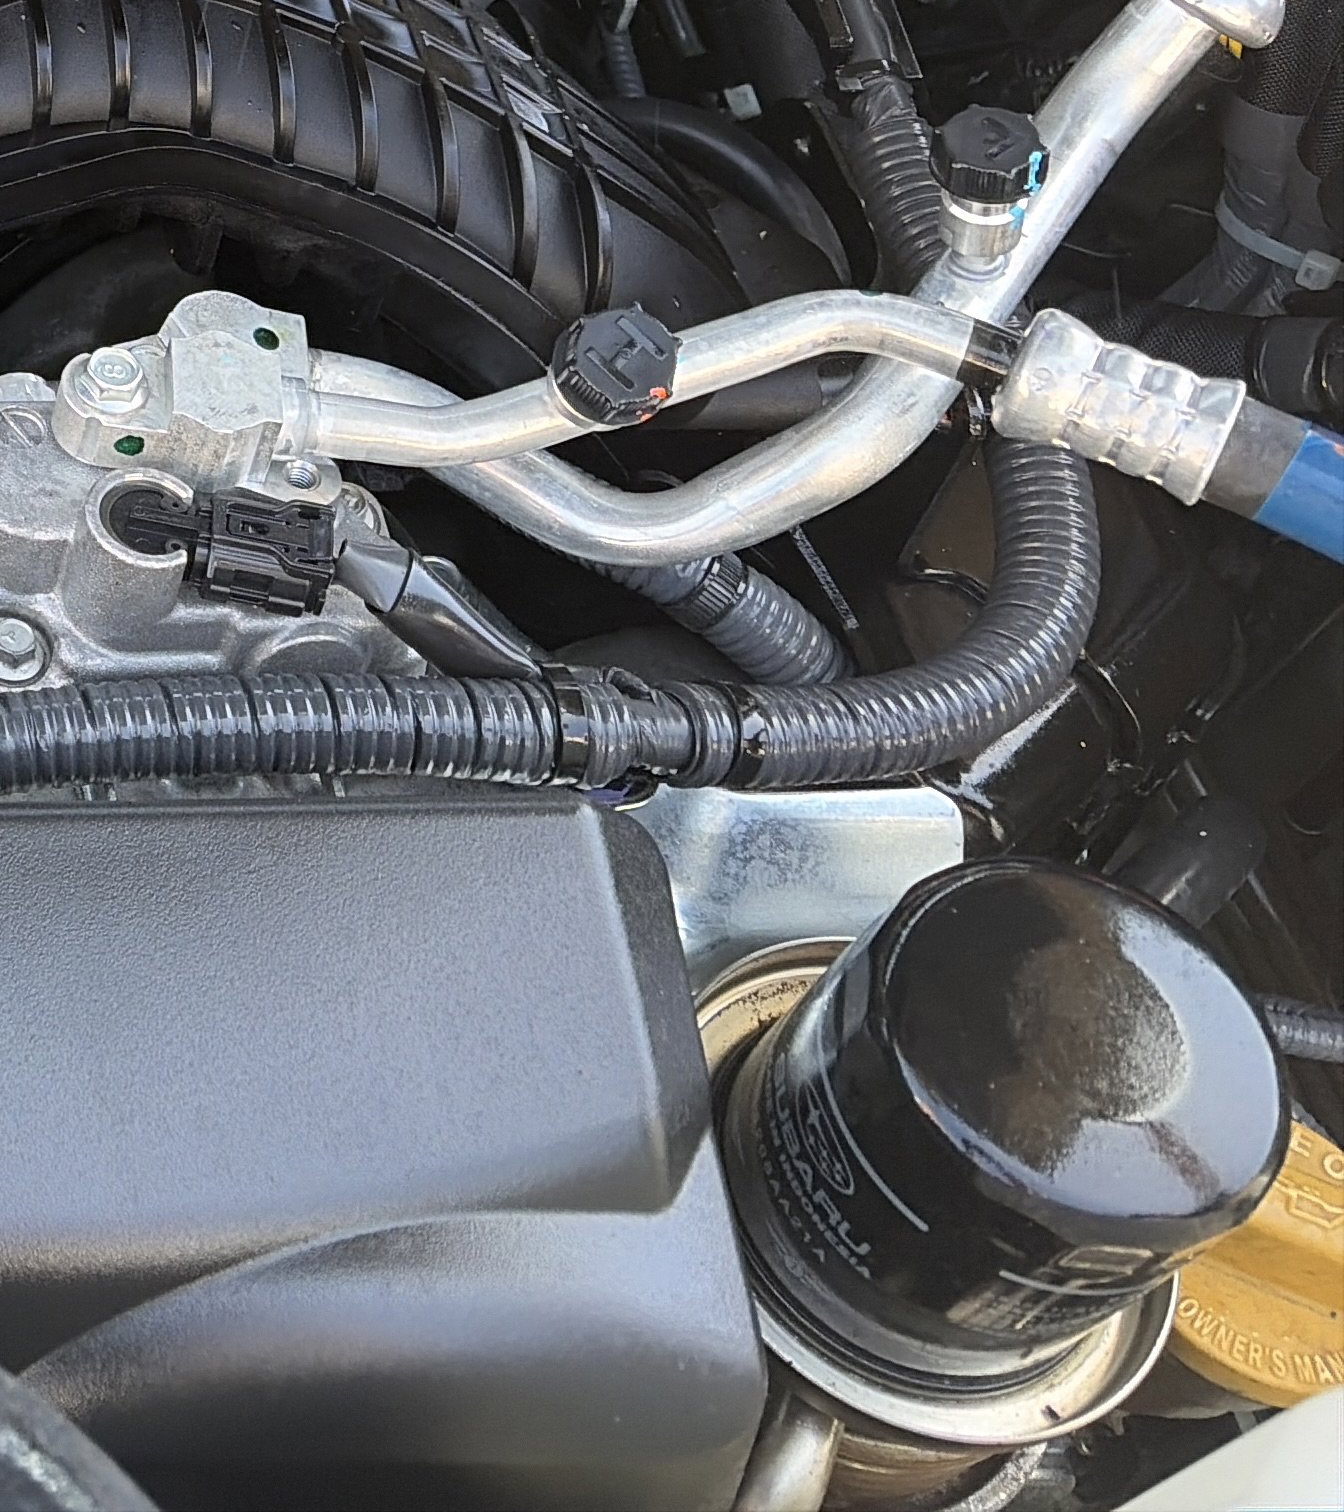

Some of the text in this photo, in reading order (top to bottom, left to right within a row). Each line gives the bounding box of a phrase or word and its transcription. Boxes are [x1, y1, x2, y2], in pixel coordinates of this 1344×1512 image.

[585, 315, 667, 390] H
[774, 1051, 871, 1255] SUBARU
[779, 1152, 871, 1279] INDONESIA
[1178, 1298, 1288, 1377] OWNER'S
